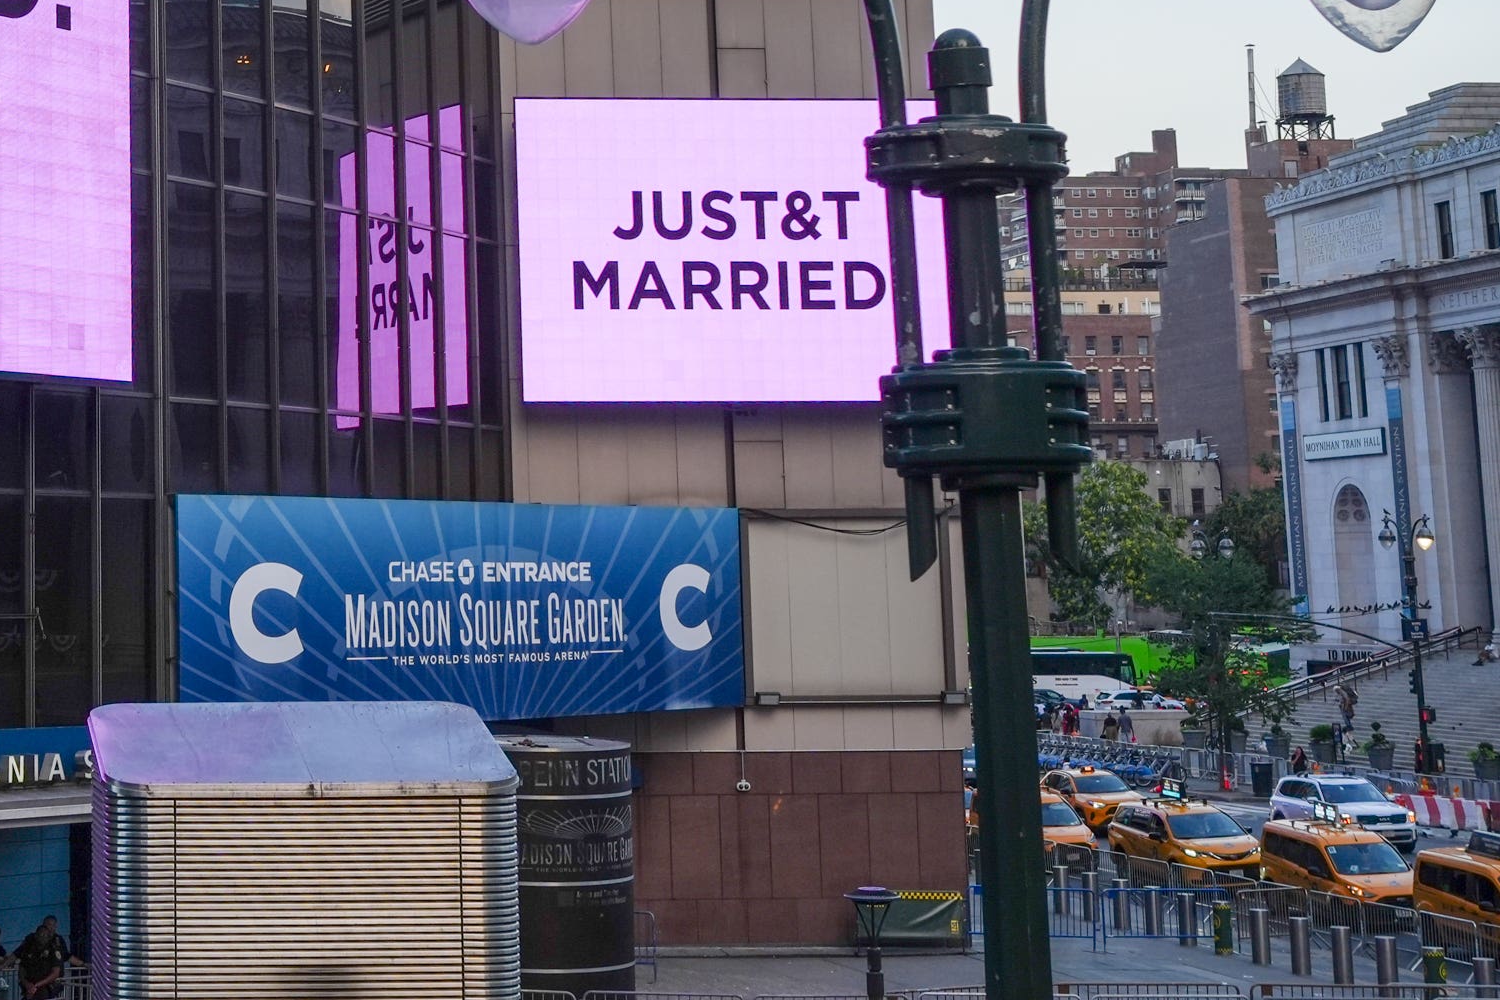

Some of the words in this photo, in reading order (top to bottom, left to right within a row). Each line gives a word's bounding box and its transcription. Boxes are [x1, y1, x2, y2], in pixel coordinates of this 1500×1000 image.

[613, 190, 861, 241] JUST&T
[1439, 286, 1500, 309] NEITHER
[1305, 441, 1340, 452] MOYNIHAN
[1341, 439, 1361, 449] TRAIN
[1363, 436, 1380, 447] HALL
[388, 561, 455, 582] CHASE
[482, 561, 592, 582] ENTRANCE
[229, 562, 304, 664] C
[659, 563, 713, 652] C
[345, 594, 451, 648] MADISON
[459, 592, 541, 650] SQUARE
[392, 655, 415, 666] THE
[419, 655, 470, 665] WORLD'S
[475, 654, 504, 664] MOST
[508, 652, 550, 663] FAMOUS
[1328, 649, 1338, 661] TO
